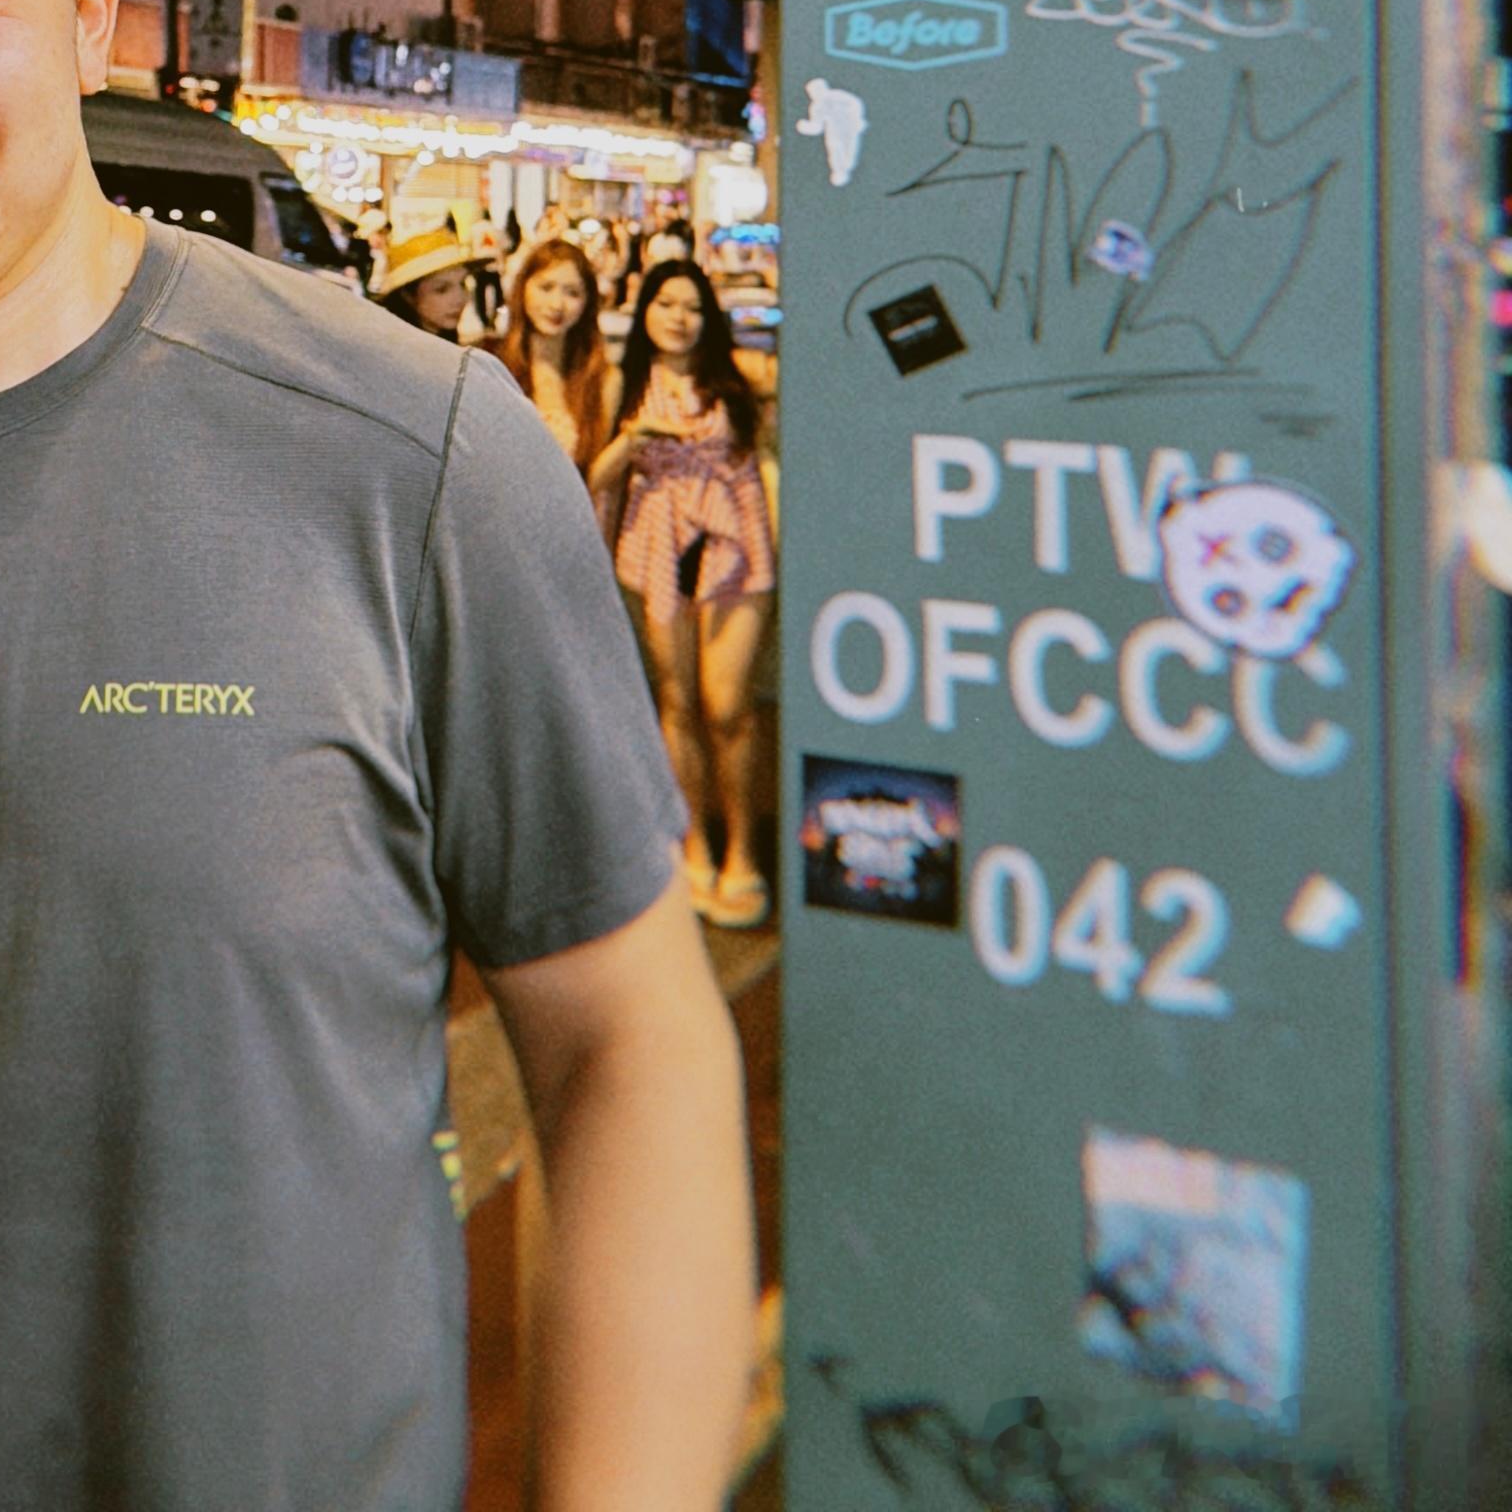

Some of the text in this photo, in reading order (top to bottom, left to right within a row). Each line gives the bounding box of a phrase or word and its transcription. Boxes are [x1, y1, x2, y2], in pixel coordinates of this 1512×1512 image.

[846, 11, 982, 56] Before
[80, 681, 255, 717] ARC'TERYX
[970, 845, 1234, 1019] 042
